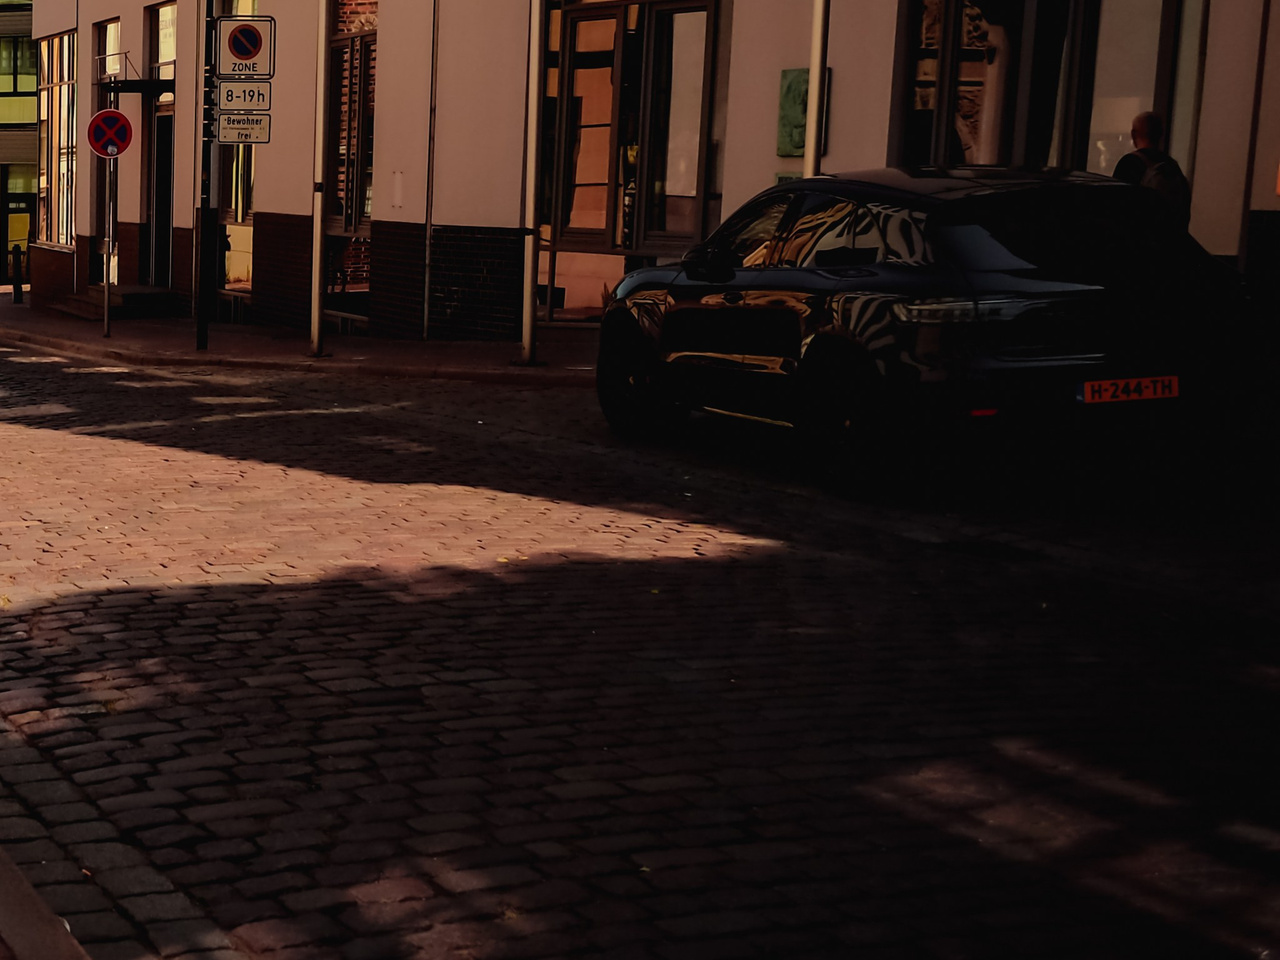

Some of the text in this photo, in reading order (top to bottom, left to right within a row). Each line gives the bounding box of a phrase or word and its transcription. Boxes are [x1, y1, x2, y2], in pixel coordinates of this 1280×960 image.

[231, 62, 258, 72] ZONE
[226, 116, 263, 126] Bewohner
[237, 131, 252, 140] frei
[1090, 379, 1173, 401] H-244-TH
